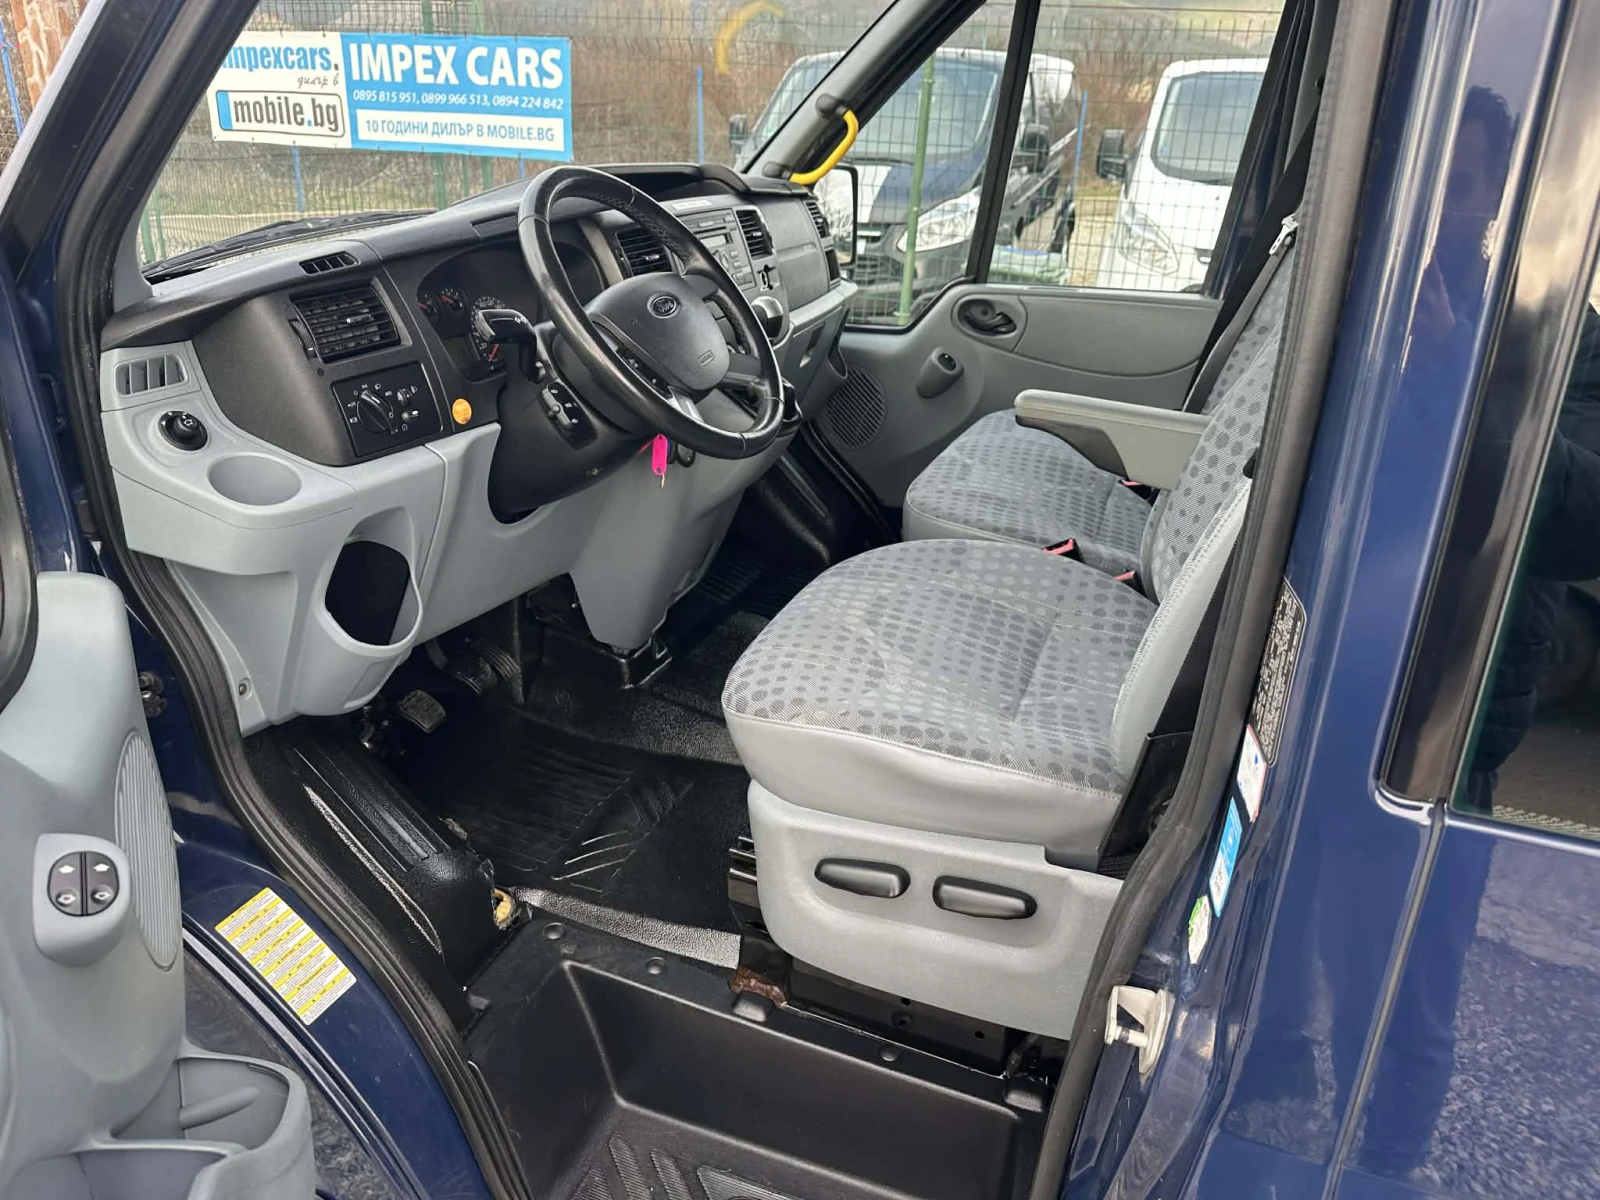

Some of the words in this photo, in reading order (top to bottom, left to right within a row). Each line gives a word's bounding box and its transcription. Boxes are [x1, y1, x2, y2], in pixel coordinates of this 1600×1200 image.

[350, 43, 459, 86] IMPEX
[466, 46, 563, 89] CARS
[233, 95, 339, 132] mobile.bg
[353, 89, 377, 101] 0895
[378, 90, 397, 103] 815
[399, 91, 420, 105] 951,
[421, 92, 447, 104] 0899
[448, 93, 468, 105] 966
[469, 93, 490, 107] 513,
[492, 94, 519, 107] 0894
[521, 96, 542, 109] 224
[543, 97, 564, 110] 842
[366, 119, 379, 133] 10
[381, 119, 429, 136] ГОДИНИ
[431, 122, 473, 137] ДИЛЪР
[487, 124, 554, 141] MOBILE.BG
